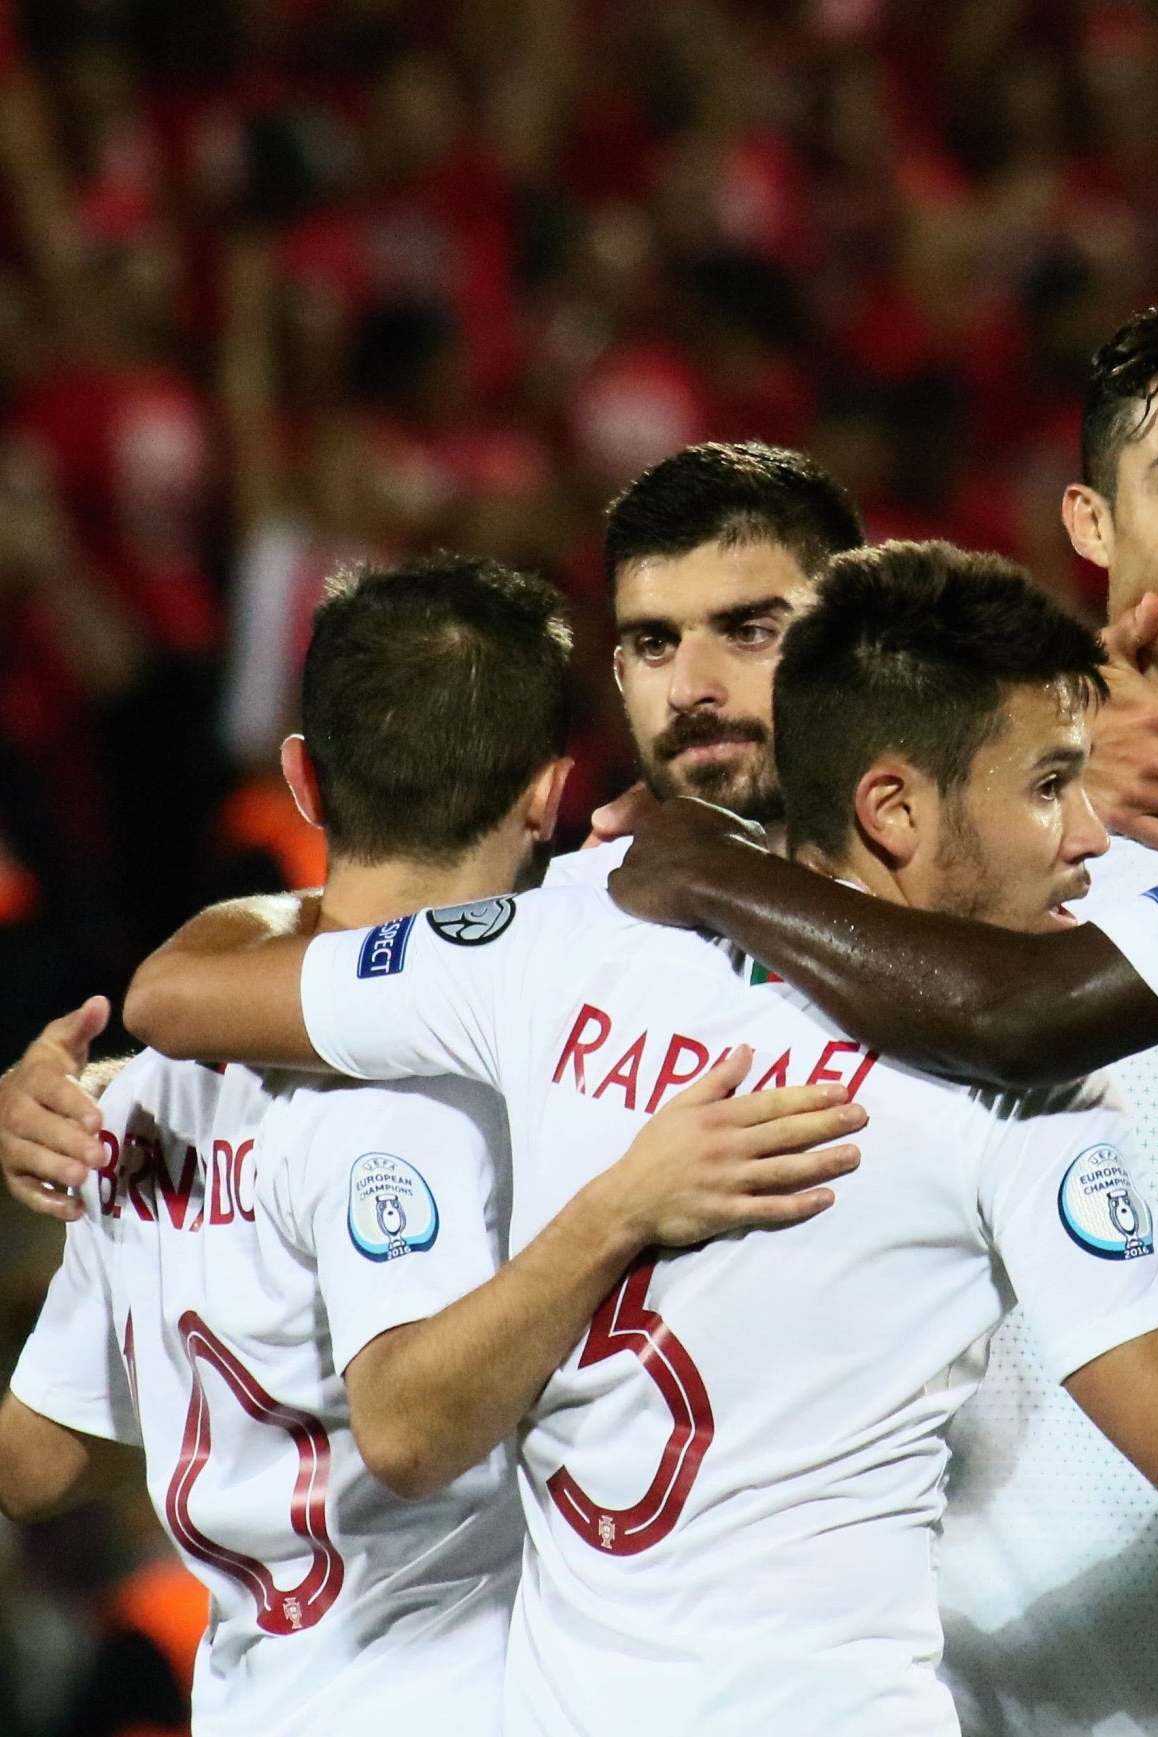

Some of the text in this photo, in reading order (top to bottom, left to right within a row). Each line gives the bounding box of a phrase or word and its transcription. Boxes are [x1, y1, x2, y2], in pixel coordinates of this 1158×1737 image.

[356, 1173, 412, 1191] EUROPEAN
[360, 1184, 414, 1201] CHAMPIONS
[387, 1246, 412, 1260] 2016
[1124, 1246, 1150, 1259] 2016
[546, 1252, 715, 1557] 5
